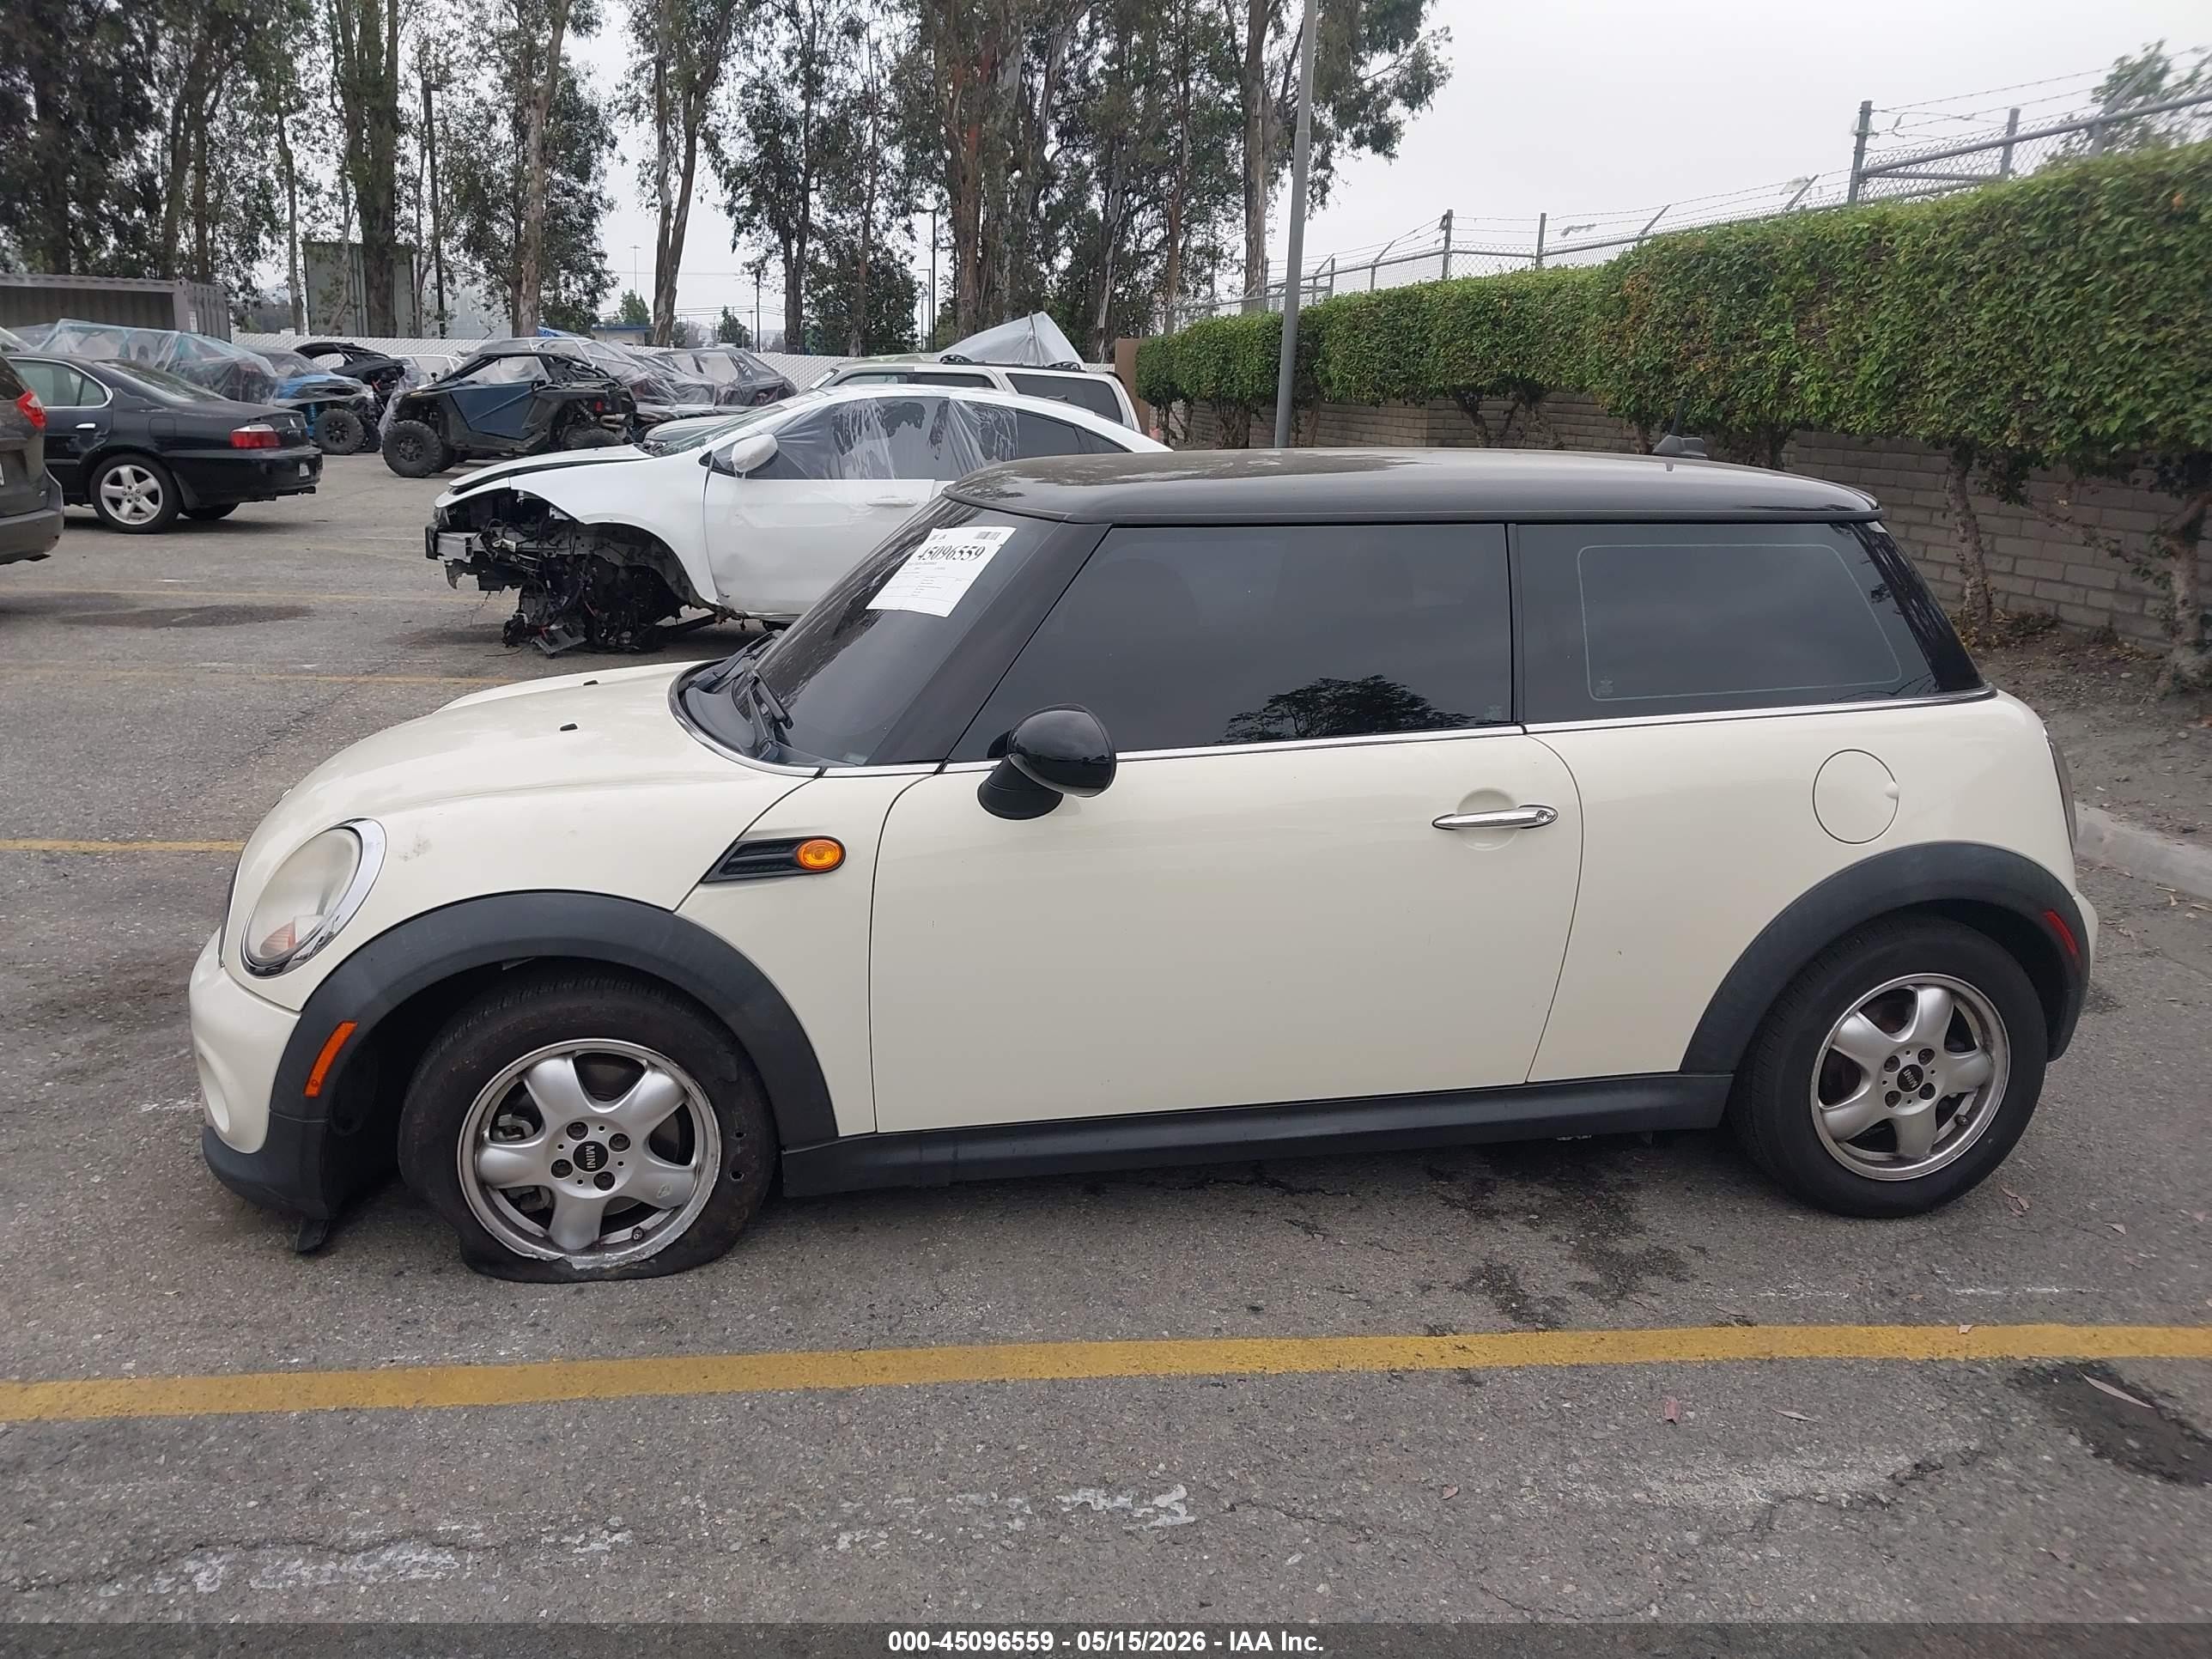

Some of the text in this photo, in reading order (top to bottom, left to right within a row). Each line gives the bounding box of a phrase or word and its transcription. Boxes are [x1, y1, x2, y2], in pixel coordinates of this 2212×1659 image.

[917, 544, 986, 561] 45096559
[1903, 1069, 1917, 1088] MINI
[586, 1146, 596, 1169] MINI
